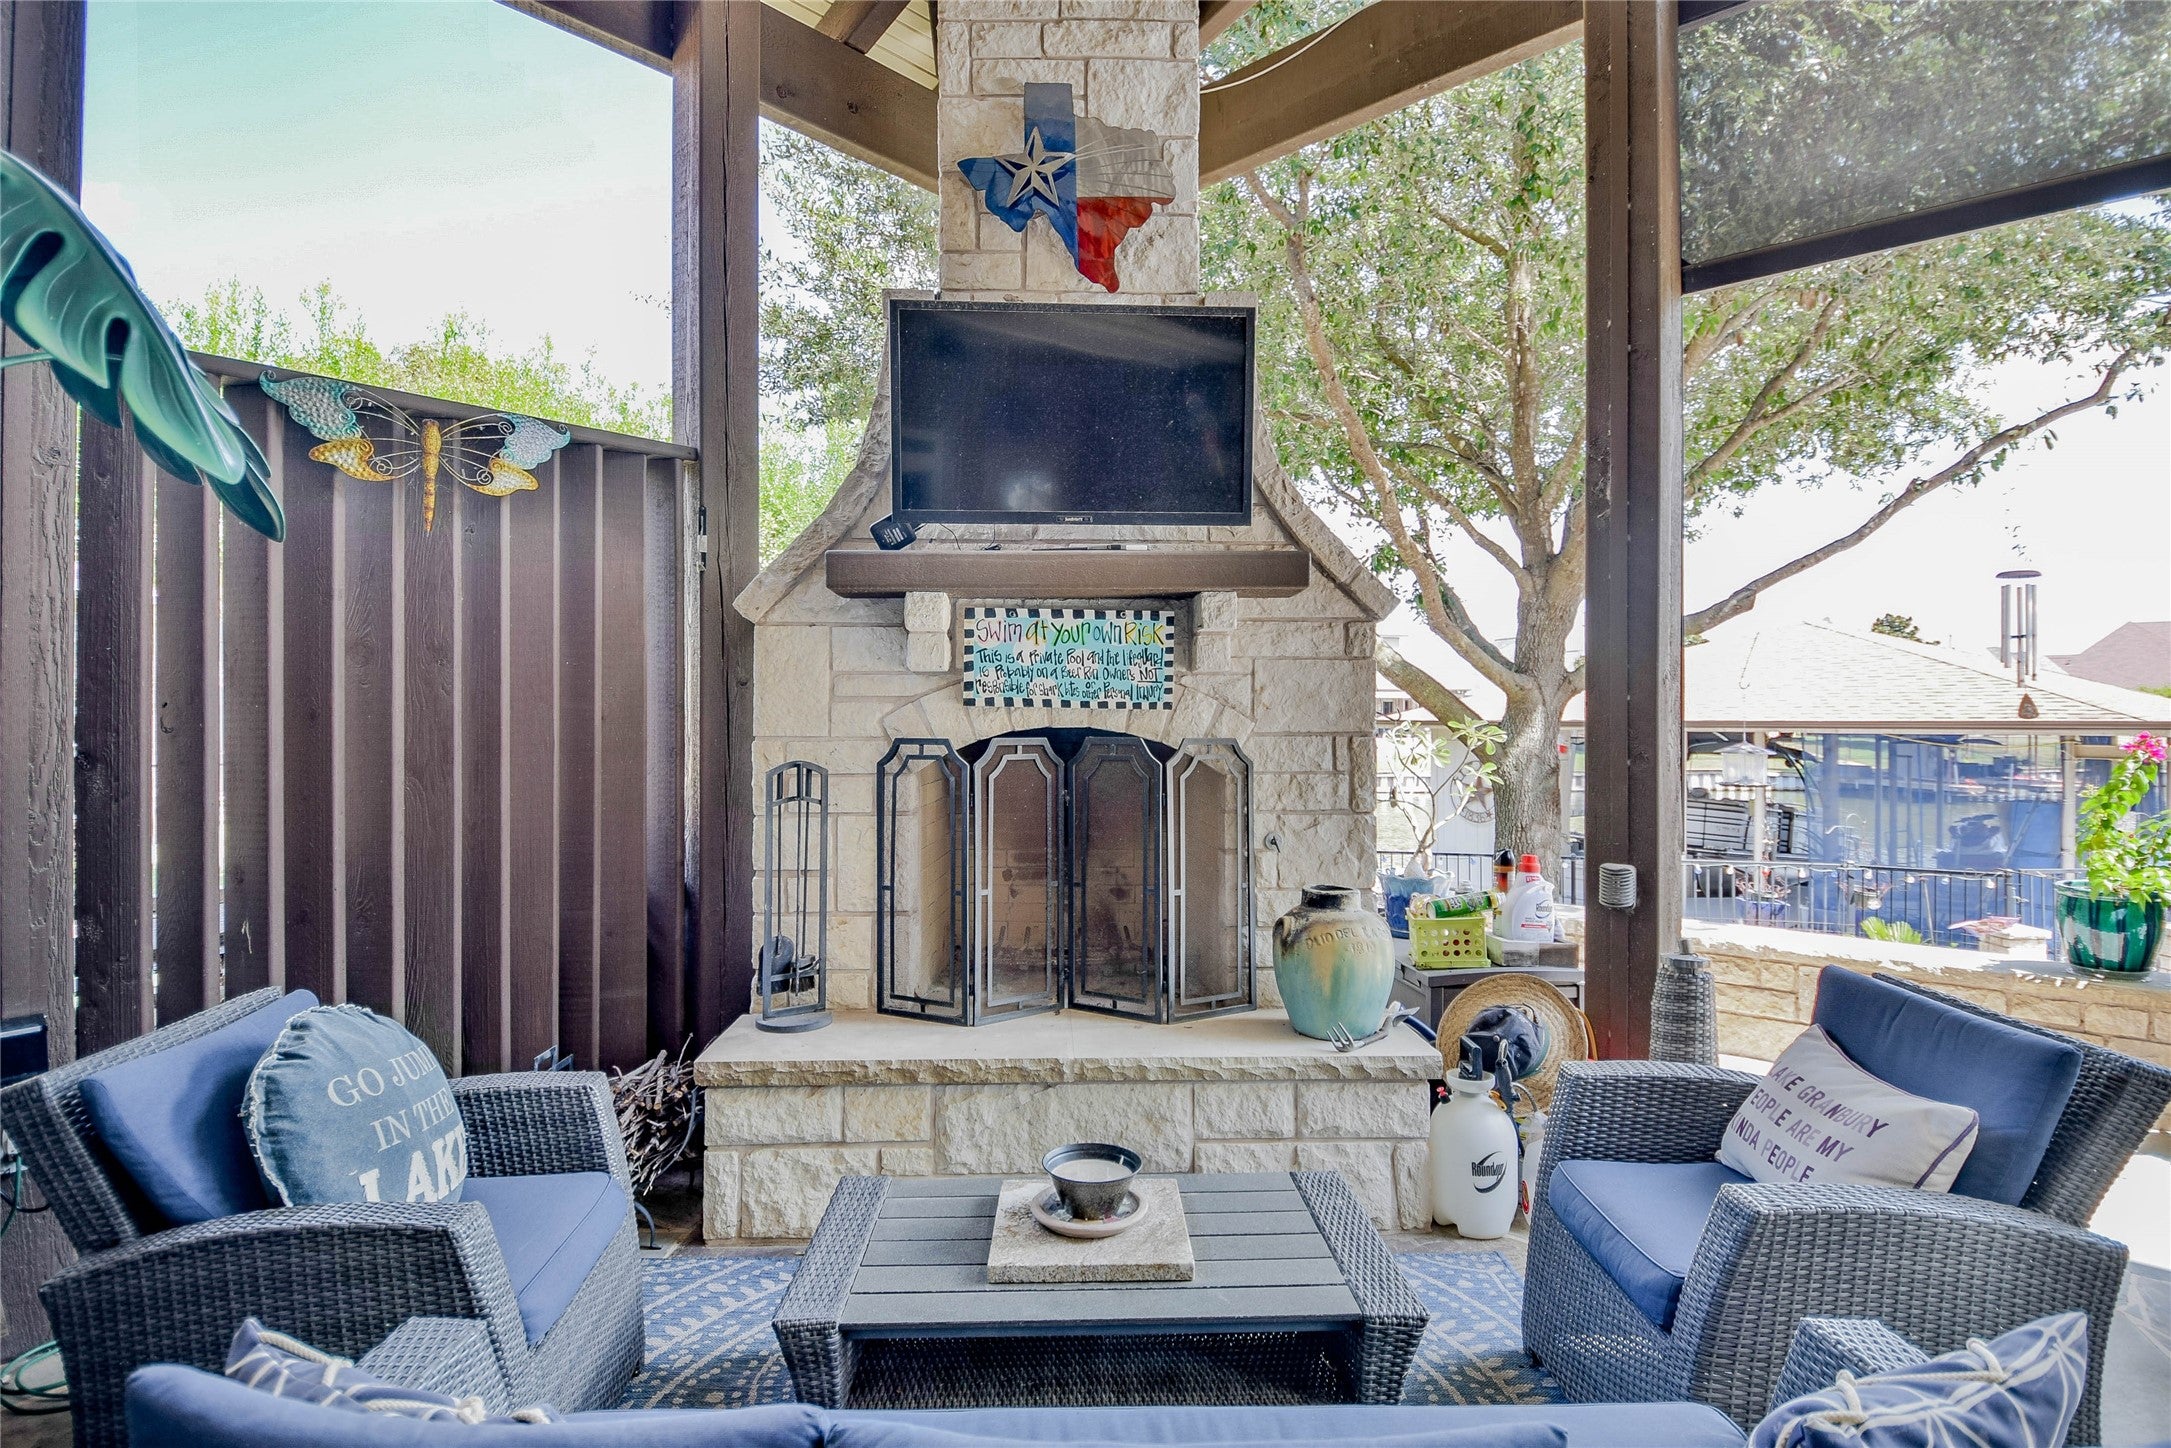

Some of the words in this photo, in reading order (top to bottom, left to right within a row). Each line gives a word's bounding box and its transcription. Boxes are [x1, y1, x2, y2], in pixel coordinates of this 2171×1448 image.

[976, 619, 1022, 643] Swim
[1026, 620, 1048, 645] at
[1093, 621, 1122, 644] own
[976, 648, 1002, 663] This
[1005, 654, 1015, 664] is
[1016, 650, 1024, 663] a
[1087, 649, 1104, 664] and
[1106, 648, 1120, 666] the
[1026, 682, 1037, 697] for
[1037, 666, 1048, 679] on
[1050, 667, 1058, 680] a
[1139, 667, 1163, 682] NOT
[327, 1067, 385, 1107] GO
[370, 1110, 411, 1153] IN
[413, 1087, 454, 1132] THE
[1751, 1088, 1792, 1127] EOPLE
[1785, 1119, 1822, 1147] ARE
[1815, 1136, 1854, 1162] MY
[1797, 1085, 1889, 1138] GRANBURY
[1471, 1162, 1504, 1180] Roundup
[1760, 1138, 1815, 1182] PEOPLE
